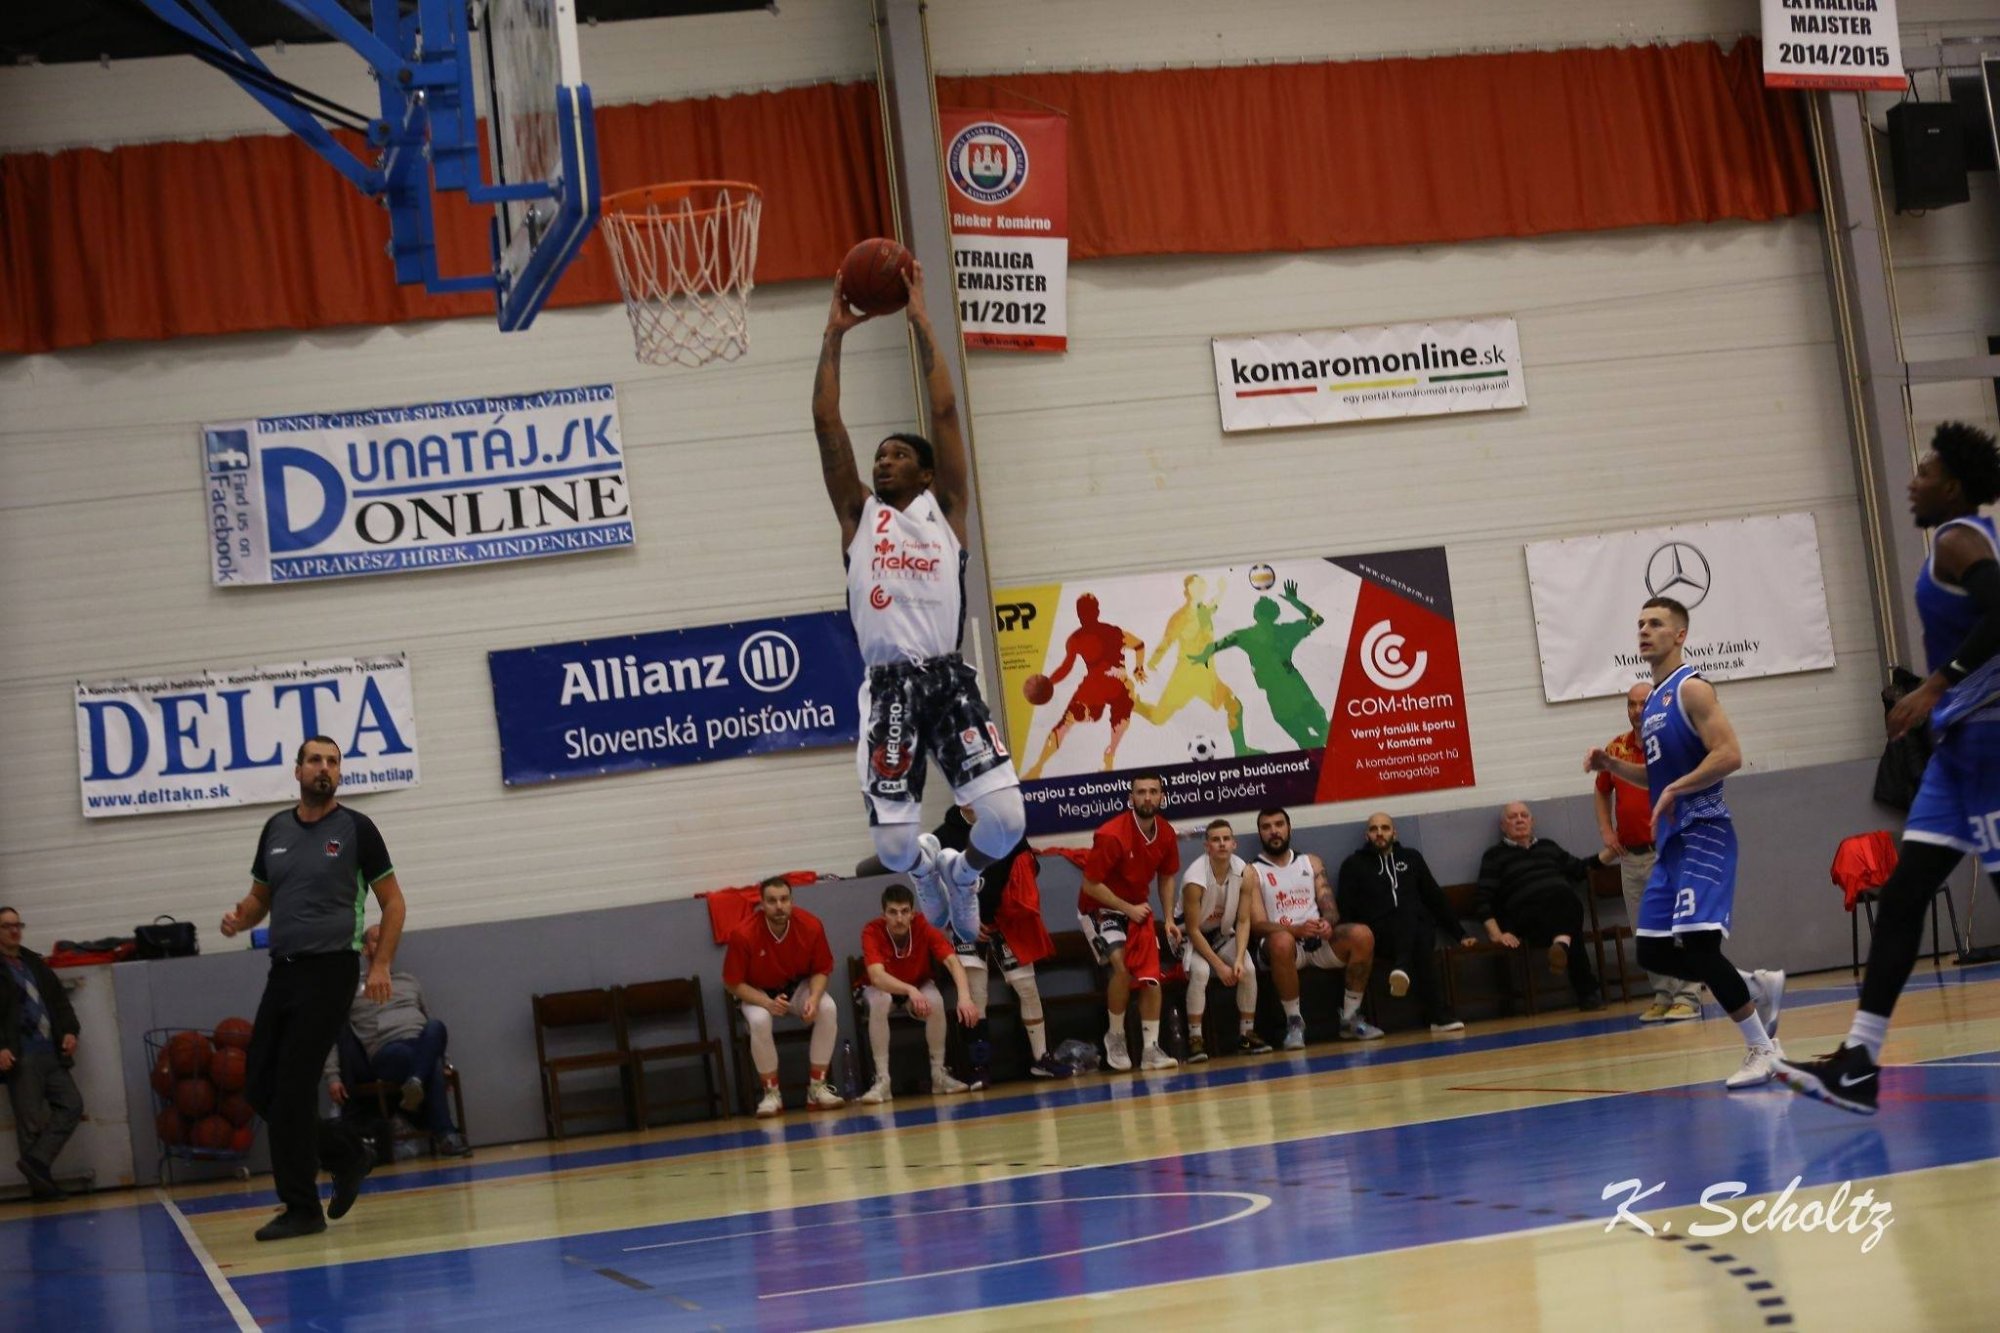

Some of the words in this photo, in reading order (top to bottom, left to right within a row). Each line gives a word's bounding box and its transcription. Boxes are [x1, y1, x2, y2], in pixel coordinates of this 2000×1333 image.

[1790, 15, 1872, 35] MAJSTER
[1779, 43, 1889, 67] 2014/2015
[997, 215, 1051, 230] Komárno
[958, 272, 1047, 292] EMAJSTER
[960, 300, 1047, 324] 11/2012
[1231, 342, 1506, 385] komaromonline.sk
[1342, 394, 1360, 404] egy
[1361, 390, 1390, 404] portál
[1391, 385, 1447, 399] Komáromról
[413, 400, 482, 422] SPRÁVY
[484, 396, 520, 415] PRE
[234, 474, 250, 507] Find
[355, 475, 629, 544] ONLINE
[876, 509, 892, 534] 2
[211, 475, 238, 583] Facebook
[237, 513, 249, 532] us
[239, 538, 251, 557] on
[272, 550, 397, 581] NAPRAKÉSZ
[478, 525, 632, 559] MINDENKINEK
[872, 551, 940, 572] rieker
[1358, 562, 1434, 605] www.comtherm.sk
[1683, 642, 1714, 659] Nové
[1717, 638, 1760, 655] Zámky
[560, 653, 730, 705] Allianz
[1347, 692, 1454, 717] COM-therm
[79, 675, 414, 783] DELTA
[565, 714, 699, 760] Slovenská
[706, 699, 836, 748] poisťovňa
[1351, 727, 1381, 741] Verný
[1383, 721, 1420, 736] fanúšik
[1422, 719, 1456, 733] športu
[1378, 742, 1385, 750] v
[1386, 736, 1433, 750] Komárne
[1356, 760, 1364, 769] A
[1365, 753, 1416, 769] komáromi
[1418, 751, 1444, 764] sport
[1379, 764, 1441, 781] támogatója
[88, 784, 231, 809] www.deltakn.sk
[369, 767, 414, 782] hetilap
[1023, 786, 1065, 803] ergiou
[1069, 787, 1076, 796] z
[1171, 770, 1216, 787] zdrojov
[1221, 768, 1241, 783] pre
[1243, 758, 1310, 777] budúcnosť
[1058, 799, 1123, 818] Megújuló
[1204, 792, 1214, 801] a
[1217, 782, 1267, 802] jövőért
